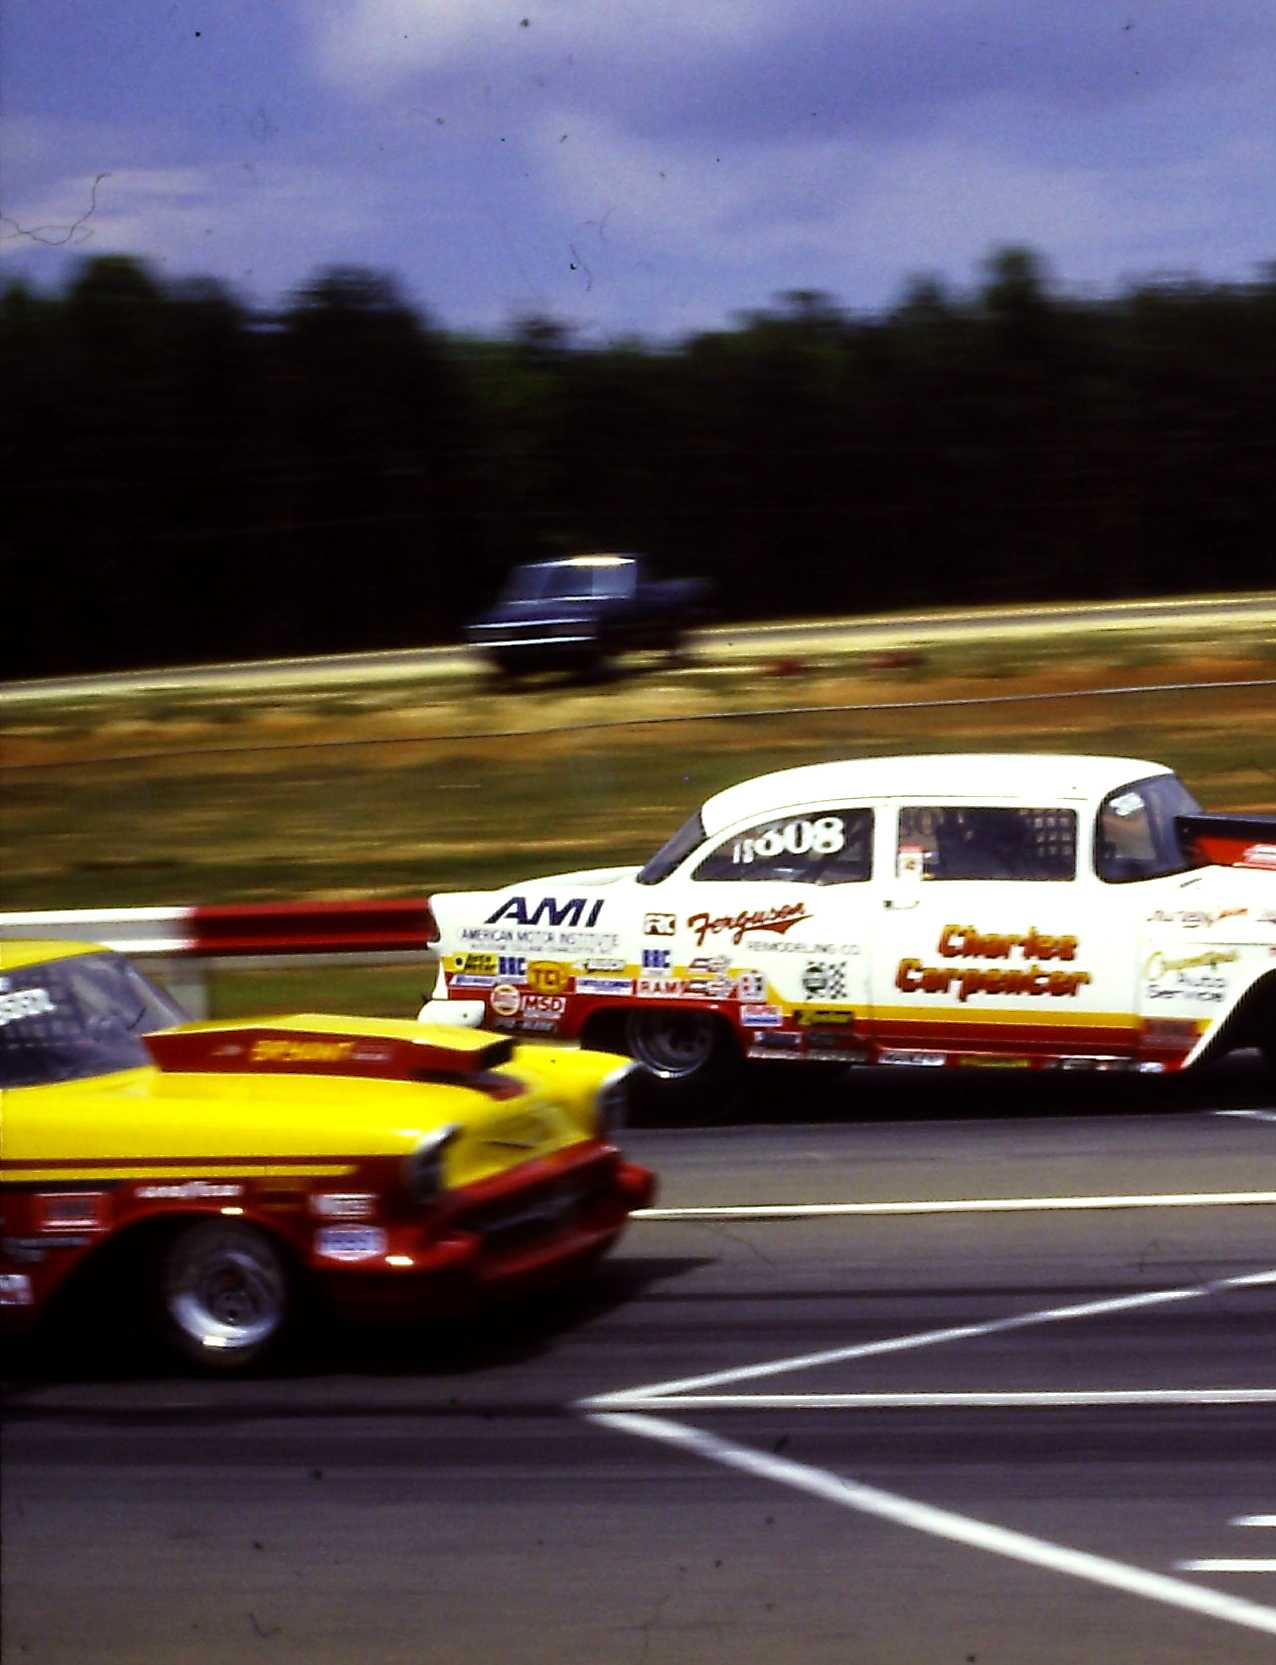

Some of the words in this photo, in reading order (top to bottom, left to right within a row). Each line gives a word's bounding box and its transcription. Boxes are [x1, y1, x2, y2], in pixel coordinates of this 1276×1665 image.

[484, 896, 605, 928] AMI
[938, 923, 1079, 961] Charles
[896, 957, 1092, 1002] Carpenter
[524, 996, 564, 1012] MSD
